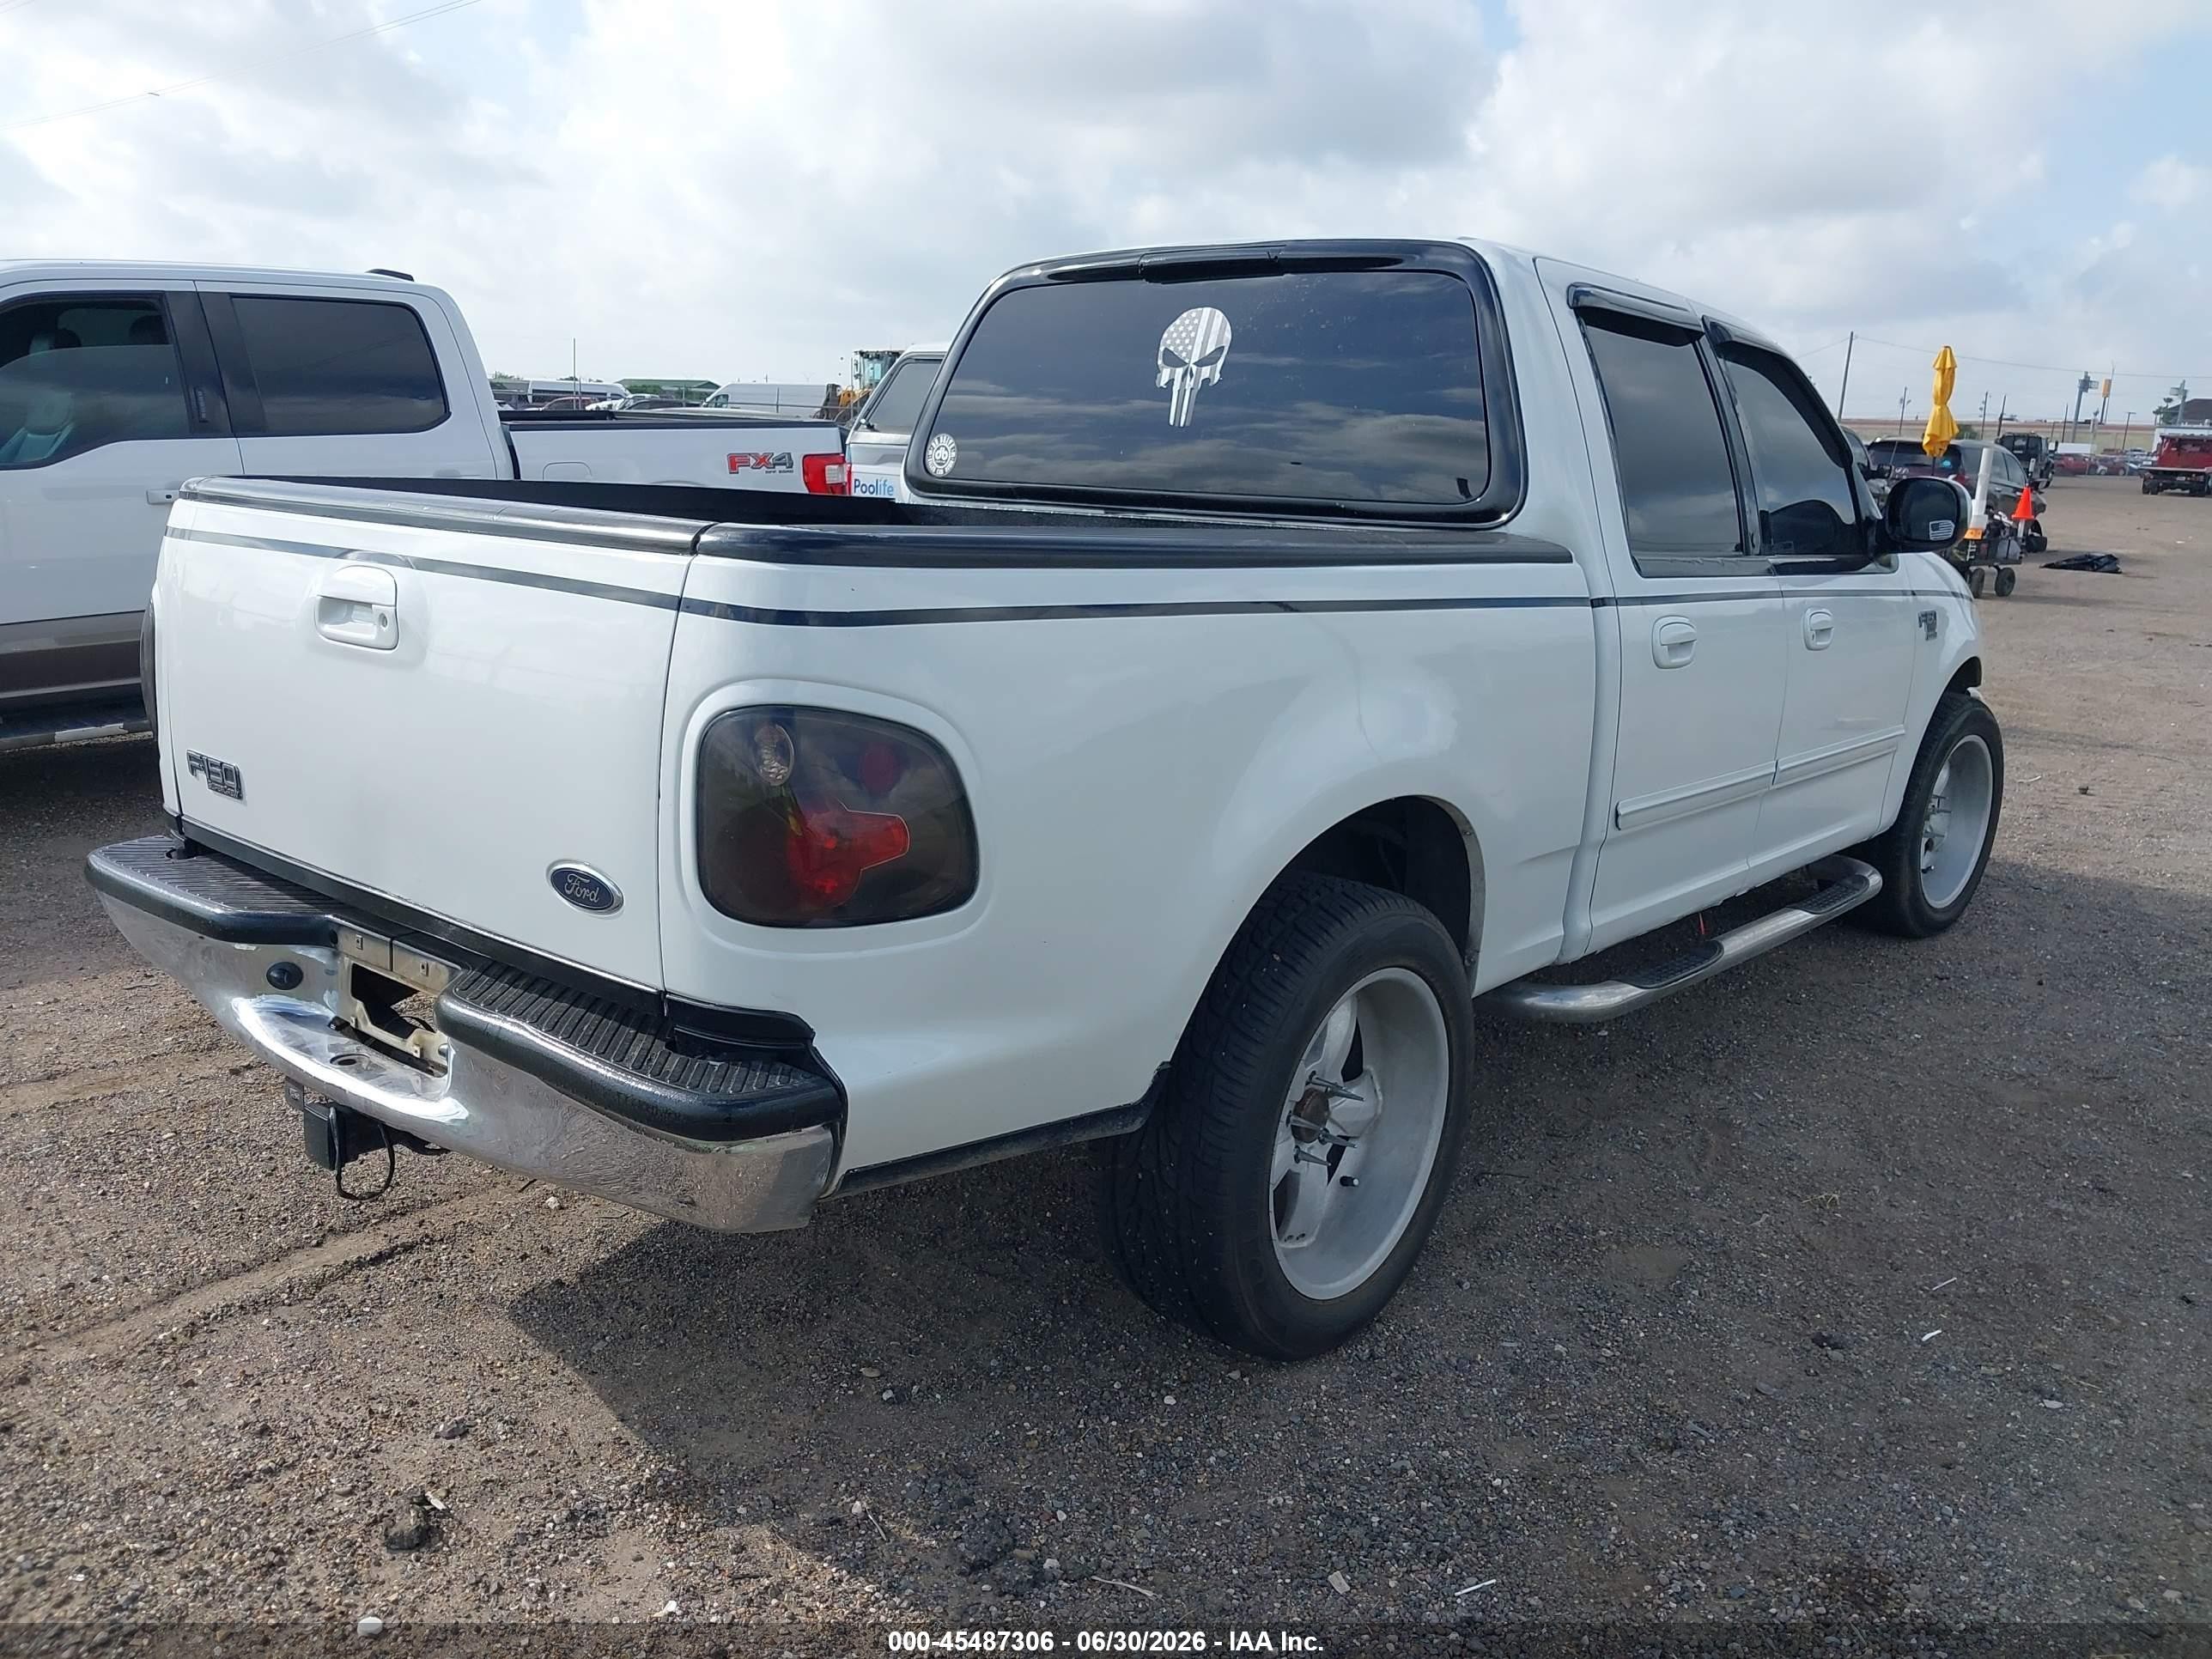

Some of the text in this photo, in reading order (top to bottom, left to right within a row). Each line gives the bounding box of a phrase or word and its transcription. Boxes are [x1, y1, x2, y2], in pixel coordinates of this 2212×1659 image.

[727, 453, 794, 474] FX4
[854, 477, 894, 496] Poolife
[564, 873, 600, 902] Ford
